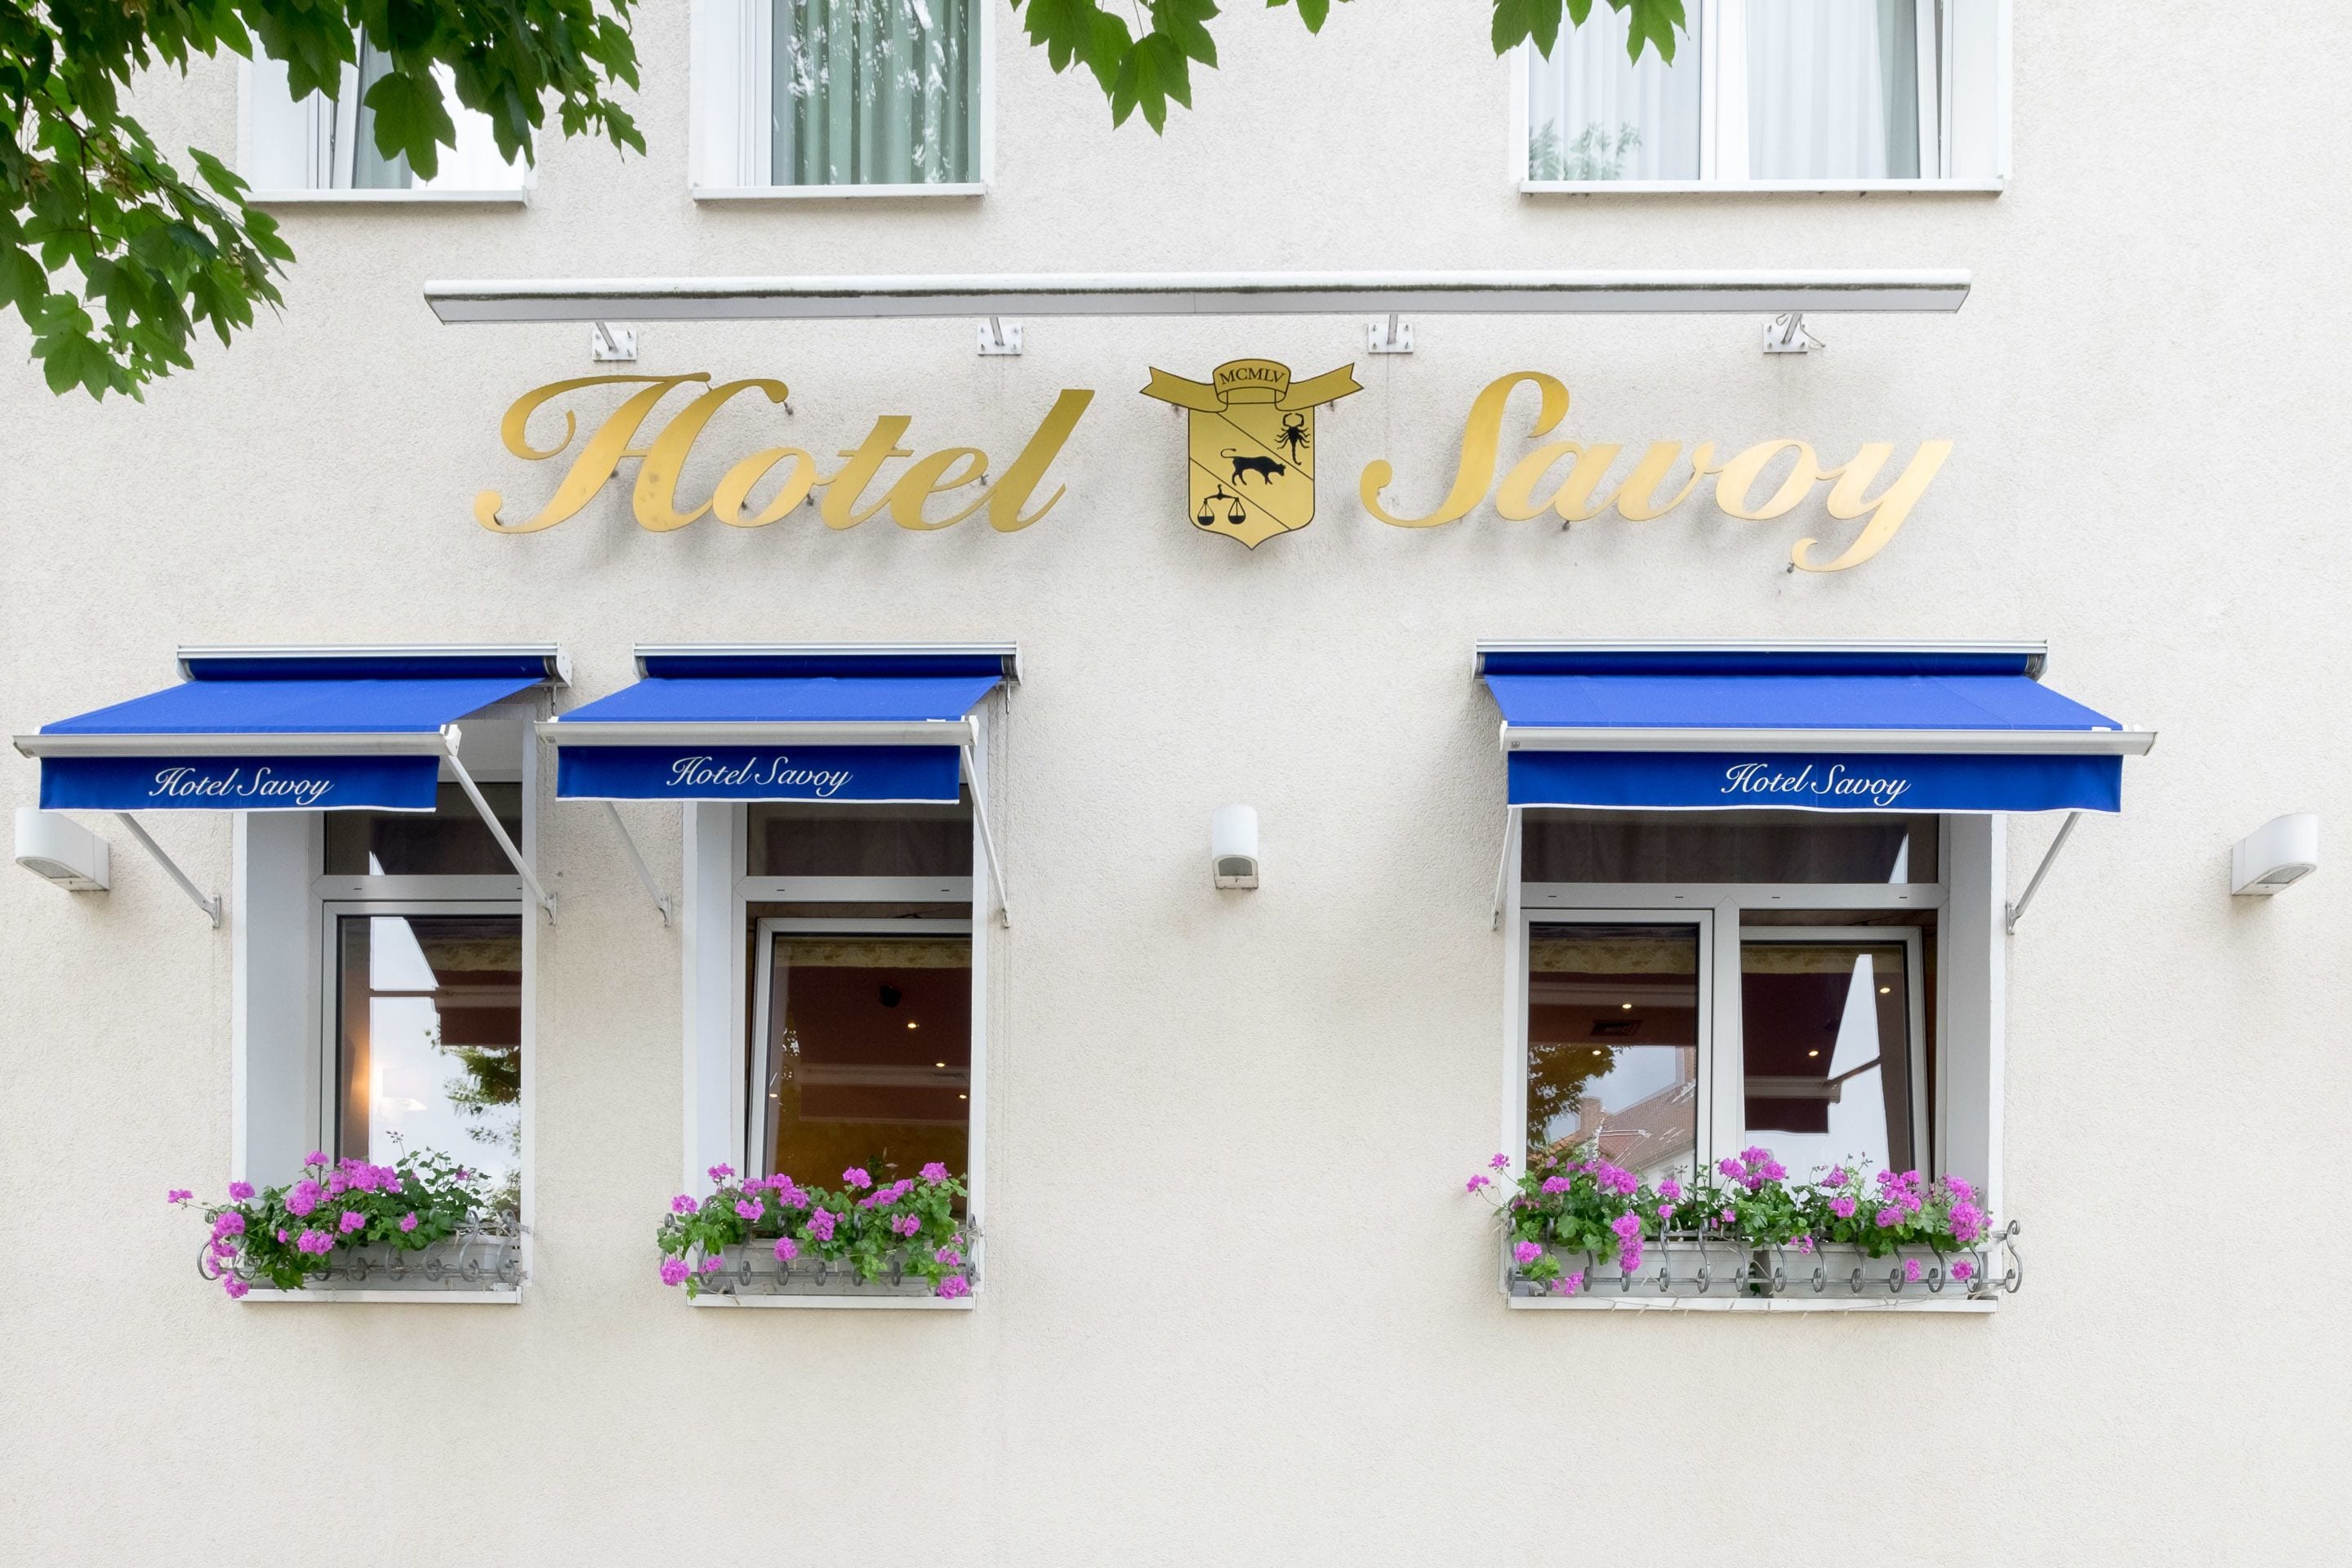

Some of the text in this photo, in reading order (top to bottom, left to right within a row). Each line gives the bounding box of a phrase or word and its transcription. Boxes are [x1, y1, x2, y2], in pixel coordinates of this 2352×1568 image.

[1219, 368, 1285, 385] MCMLV
[474, 371, 1954, 572] Hotel Savoy
[149, 767, 334, 805] Hotel Savoy
[666, 756, 853, 797] Hotel Savoy
[1721, 763, 1912, 806] Hotel Savoy
